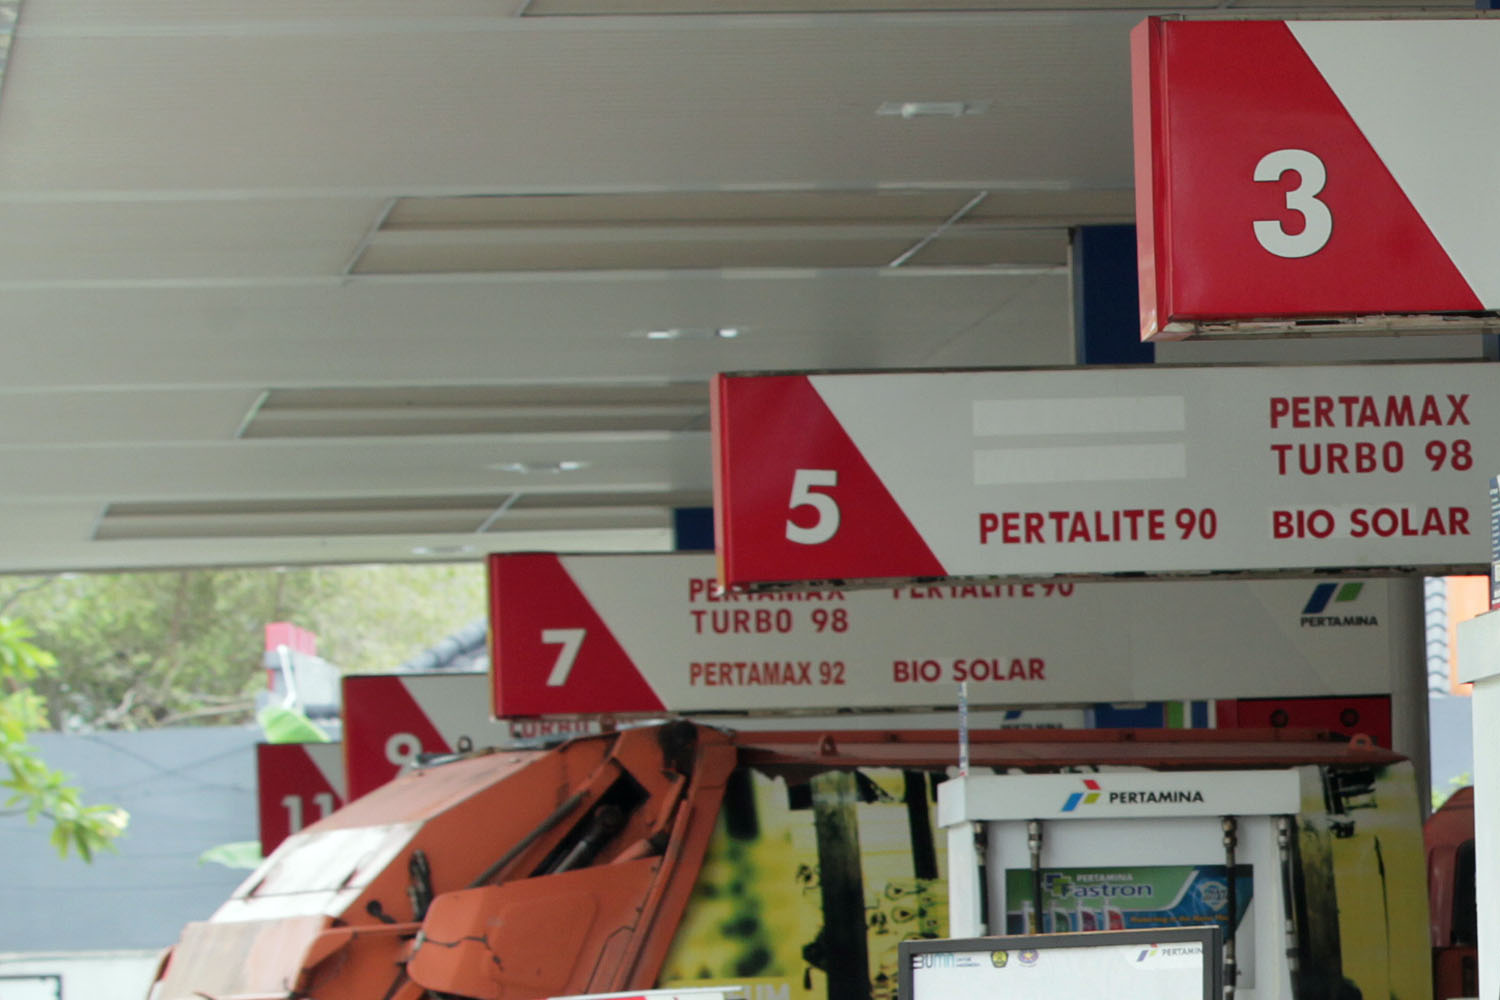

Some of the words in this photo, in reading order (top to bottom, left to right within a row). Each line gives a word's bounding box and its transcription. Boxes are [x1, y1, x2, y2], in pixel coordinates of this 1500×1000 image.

[1253, 149, 1332, 258] 3
[1270, 394, 1471, 428] PERTAMAX
[1271, 441, 1403, 475] TURBO
[1425, 440, 1473, 471] 98
[785, 469, 840, 544] 5
[1273, 510, 1335, 539] BIO
[1350, 507, 1470, 537] SOLAR
[980, 509, 1165, 544] PERTALITE
[1175, 508, 1217, 539] 90
[691, 609, 792, 633] TURBO
[812, 608, 848, 633] 98
[1301, 616, 1378, 627] PERTAMINA
[541, 629, 585, 686] 7
[690, 662, 811, 686] PERTAMAX
[819, 662, 845, 685] 92
[893, 660, 942, 682] BIO
[952, 658, 1046, 682] SOLAR
[385, 733, 422, 777] 9
[1110, 791, 1204, 804] PERTAMINA
[1062, 883, 1152, 897] Fastron
